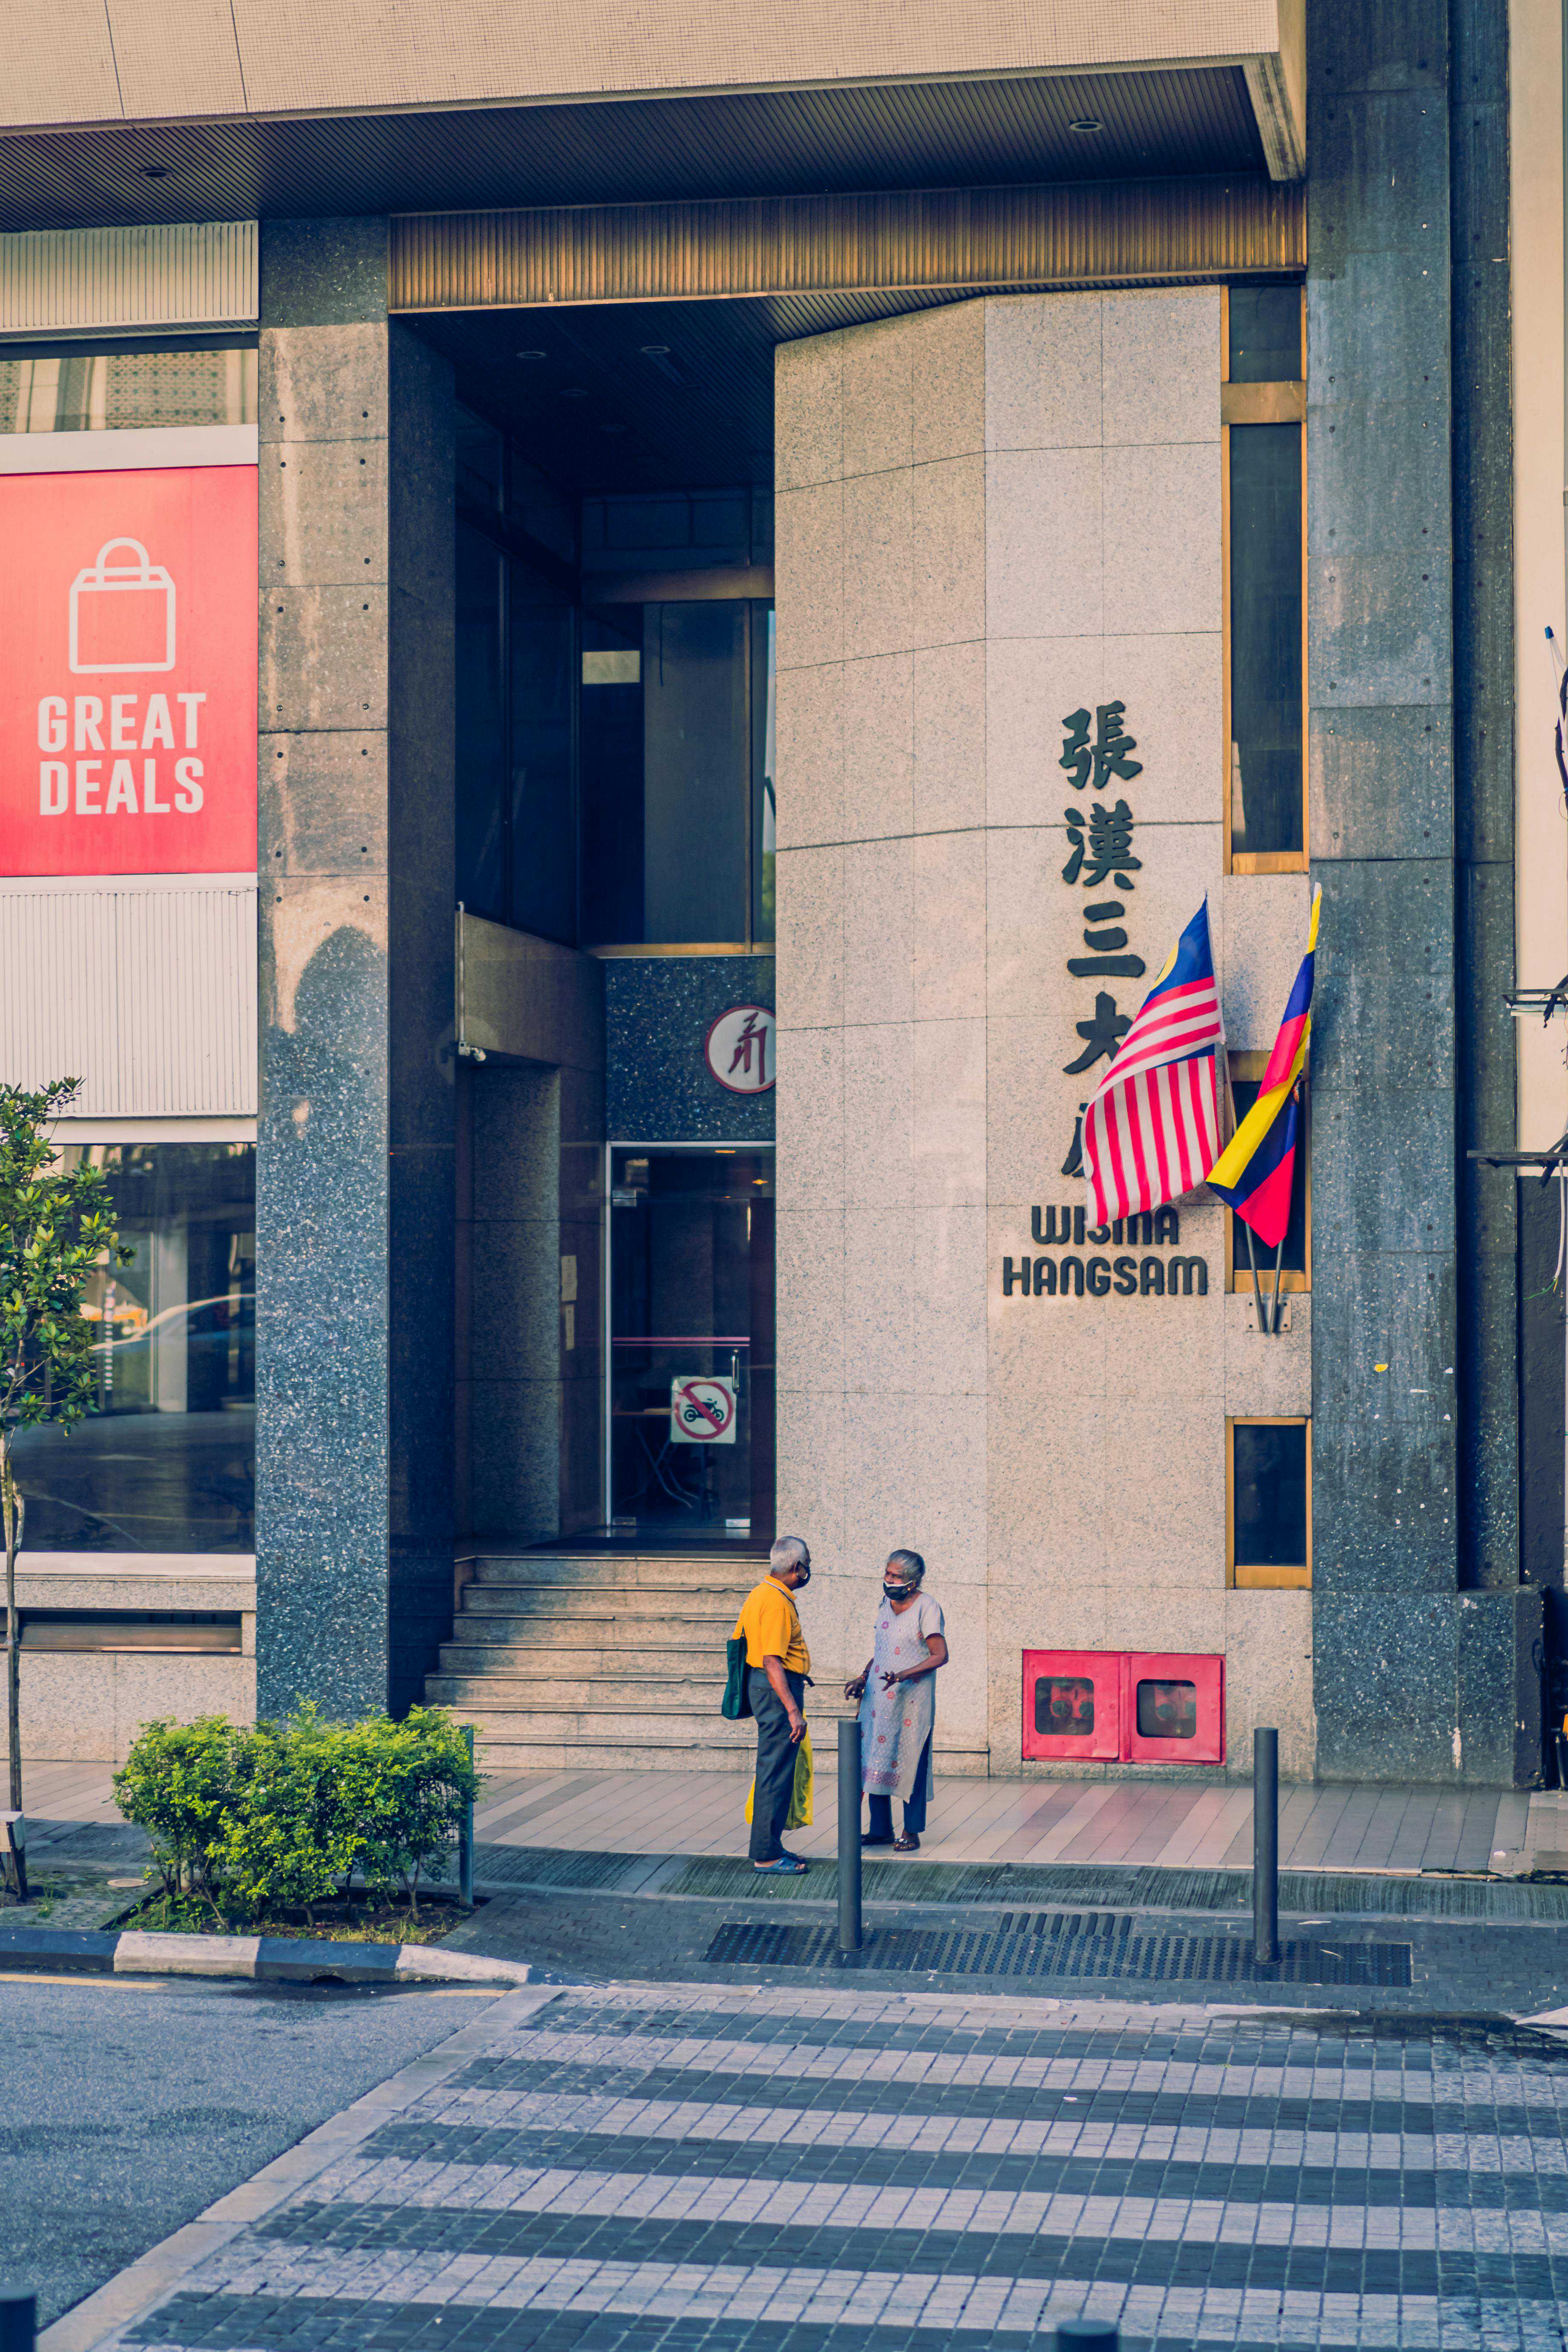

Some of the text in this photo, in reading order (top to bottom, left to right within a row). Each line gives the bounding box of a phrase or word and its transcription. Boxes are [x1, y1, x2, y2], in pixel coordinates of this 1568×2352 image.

[38, 693, 206, 752] GREAT
[40, 757, 204, 815] DEALS
[1059, 700, 1147, 1178] 張漢三大
[1003, 1255, 1209, 1296] HANGSAM
